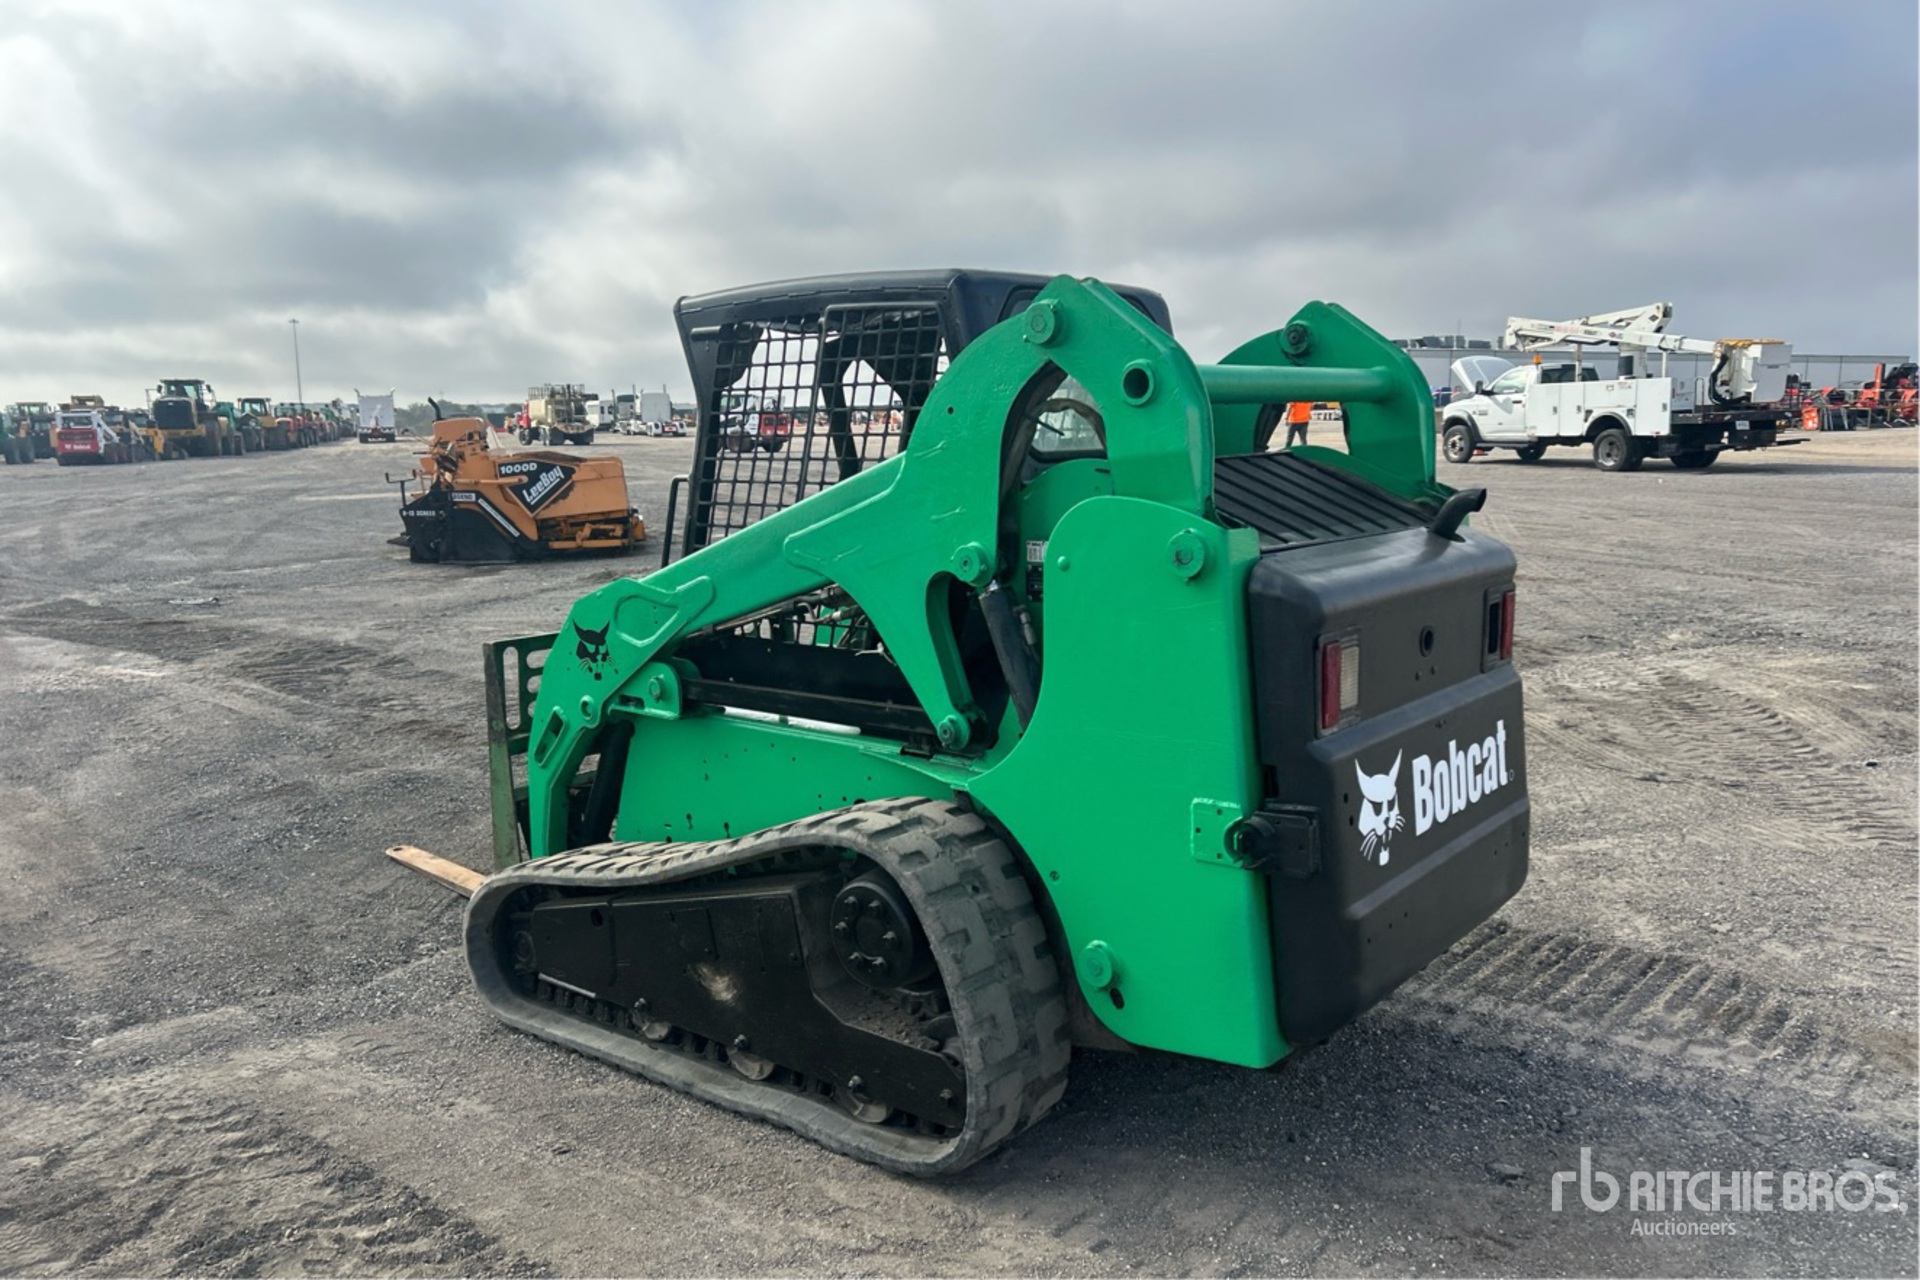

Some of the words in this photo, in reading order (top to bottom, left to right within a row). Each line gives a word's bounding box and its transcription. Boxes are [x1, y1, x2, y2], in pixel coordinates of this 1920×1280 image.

[500, 462, 537, 474] 1000D
[522, 465, 565, 503] LeeBoy
[1412, 719, 1508, 836] Bobcat
